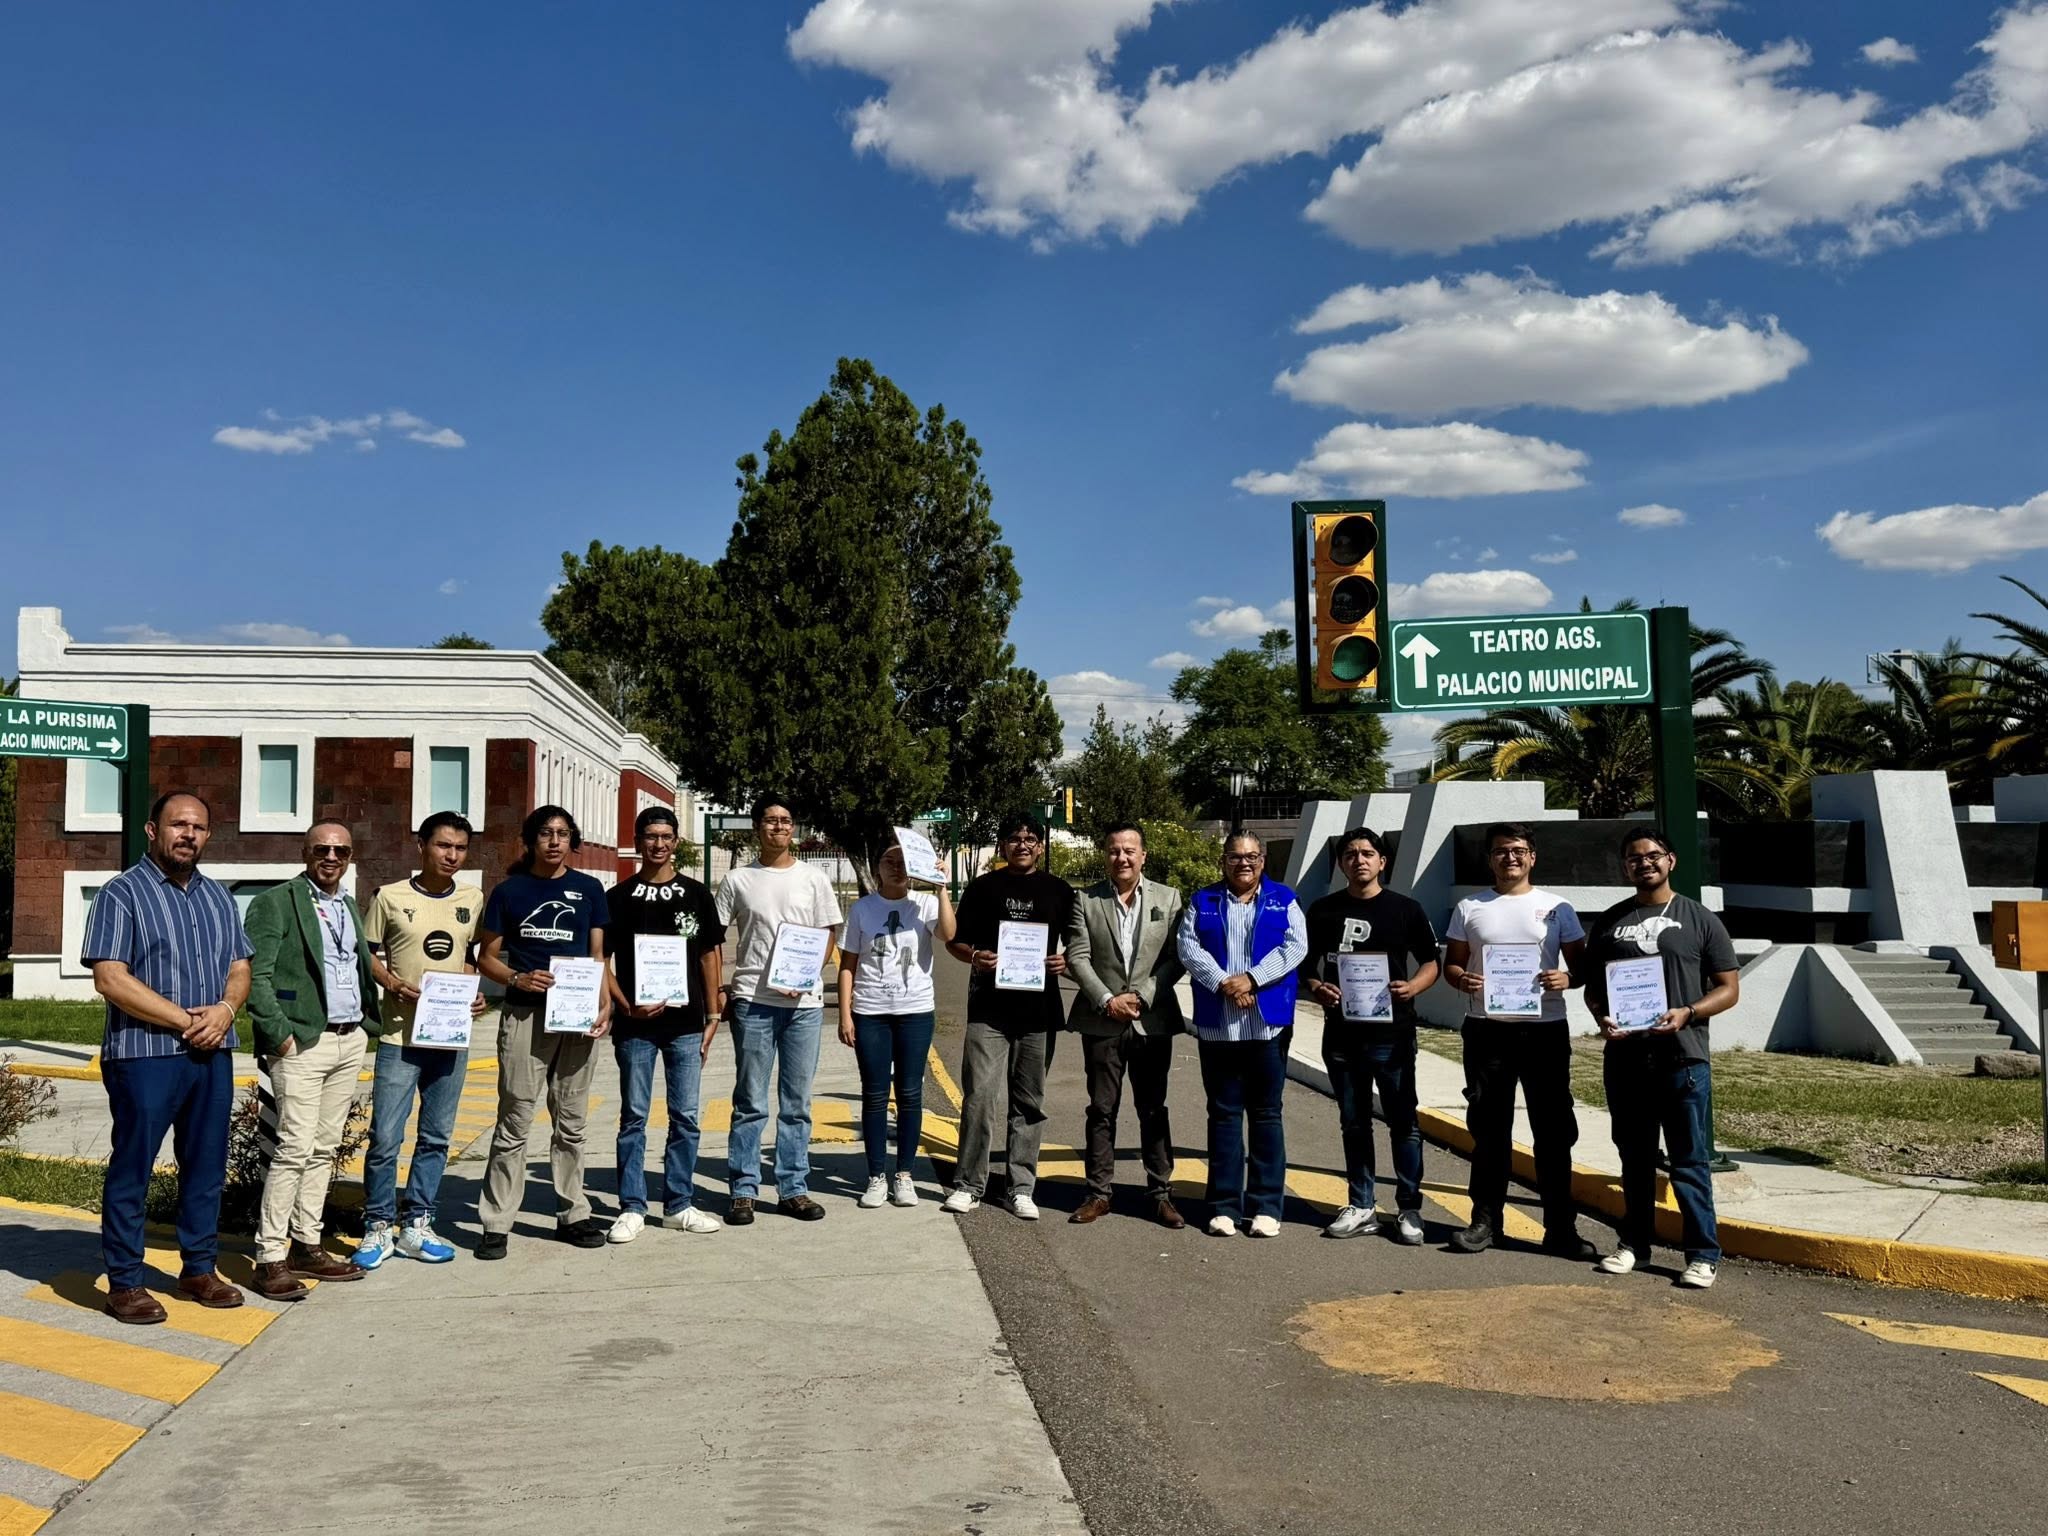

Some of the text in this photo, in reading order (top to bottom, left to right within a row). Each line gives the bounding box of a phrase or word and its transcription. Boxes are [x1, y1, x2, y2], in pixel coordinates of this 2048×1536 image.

[1470, 626, 1602, 653] TEATRO AGS.
[1437, 666, 1639, 697] PALACIO MUNICIPAL
[8, 709, 117, 729] LA PURISIMA
[31, 734, 91, 751] MUNICIPAL
[631, 882, 685, 901] BROS
[1339, 918, 1372, 952] P
